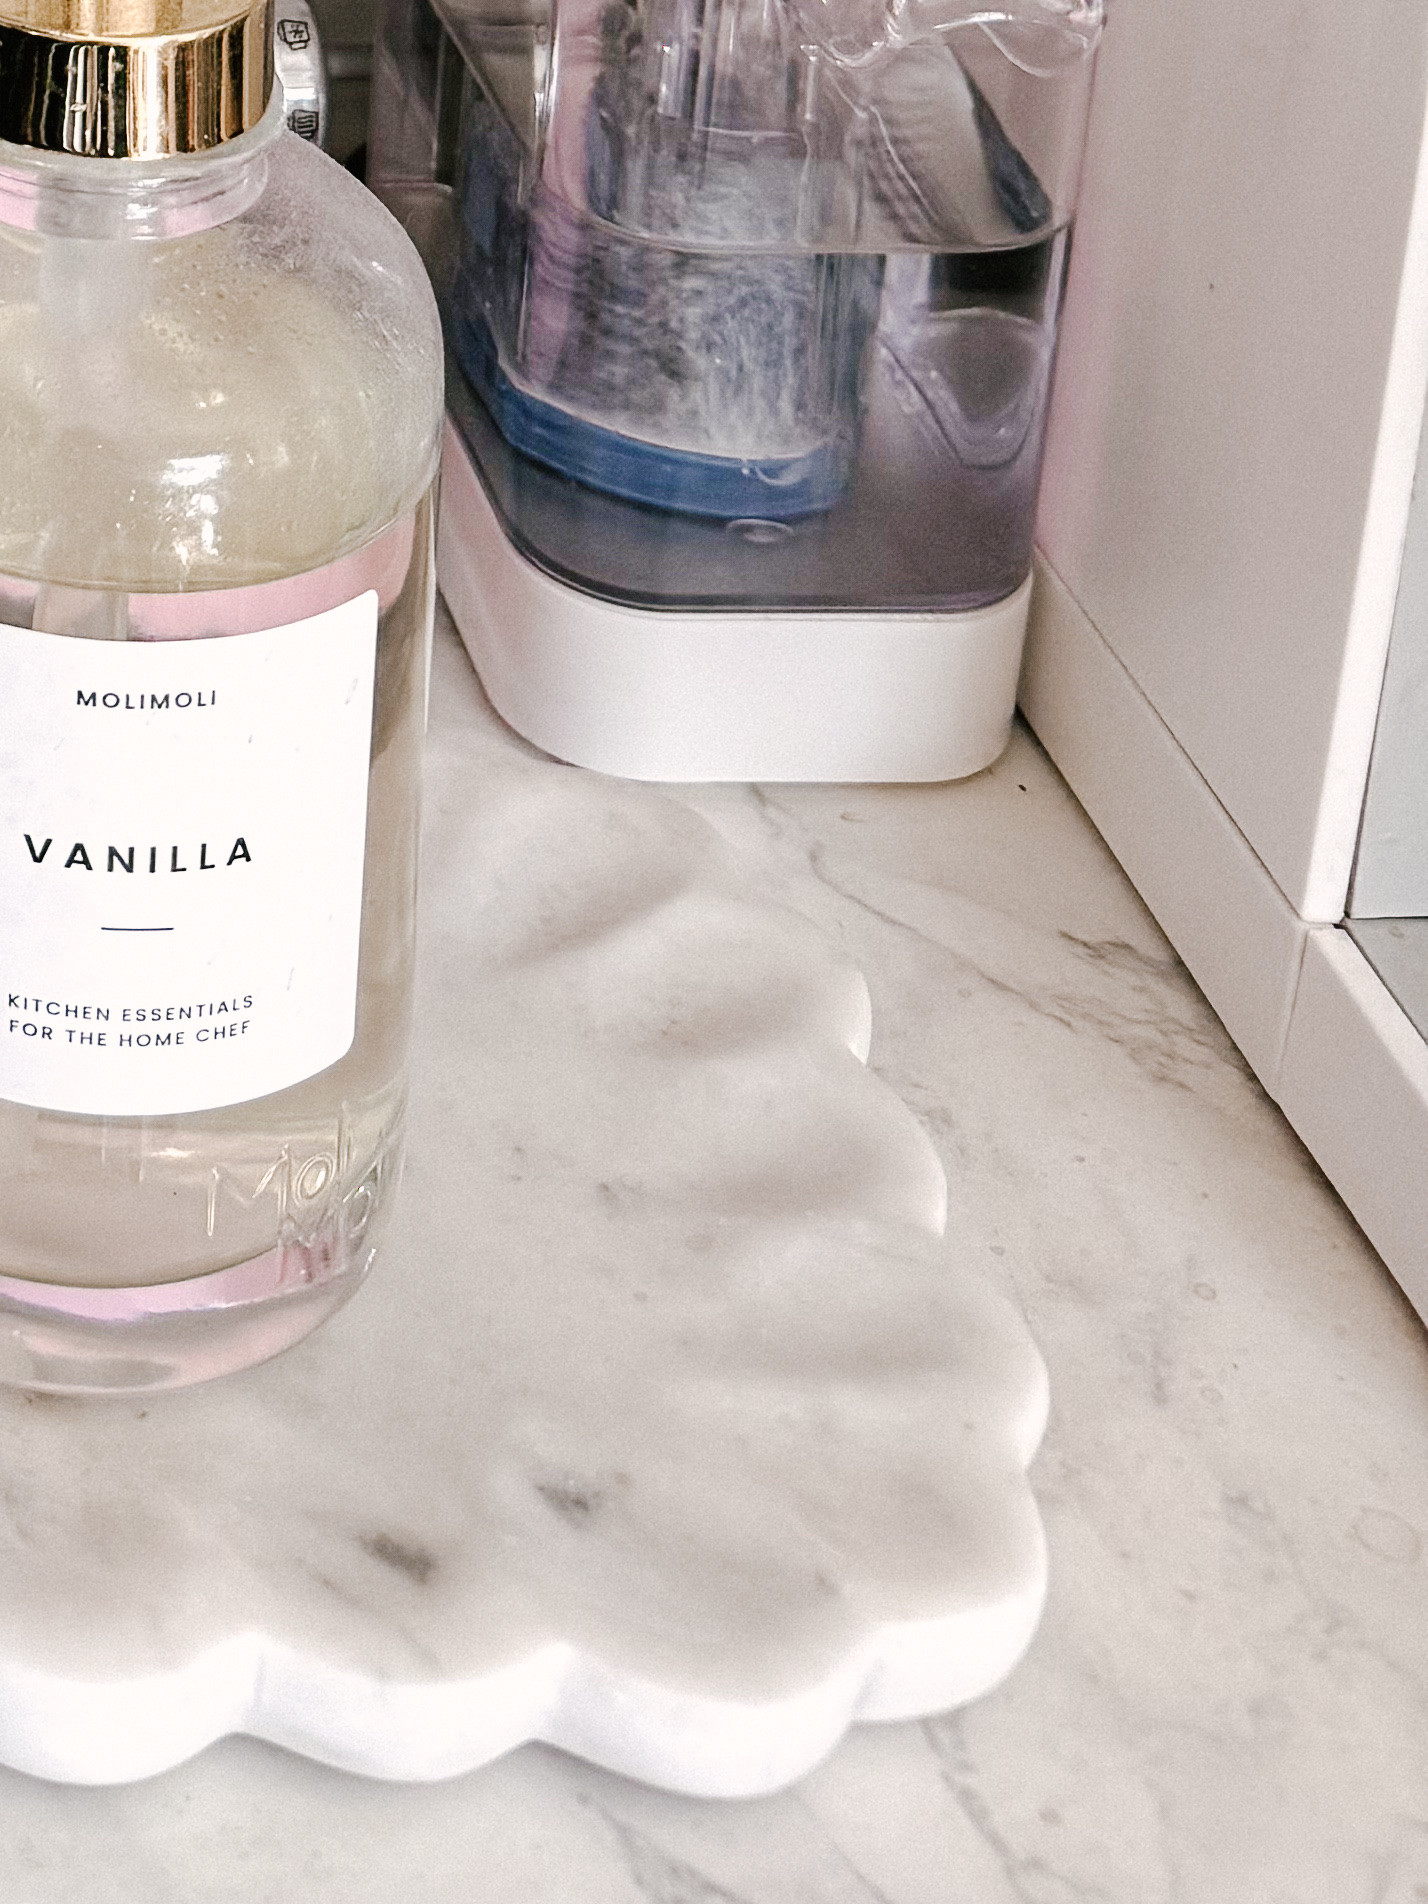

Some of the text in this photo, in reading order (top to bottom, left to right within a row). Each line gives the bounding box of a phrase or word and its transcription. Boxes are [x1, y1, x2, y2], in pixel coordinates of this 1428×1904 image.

[75, 688, 217, 711] MOLIMOLI
[22, 833, 254, 875] VANILLA
[7, 993, 254, 1022] KITCHEN ESSENTIALS
[8, 1018, 251, 1048] FOR THE HOME CHEF
